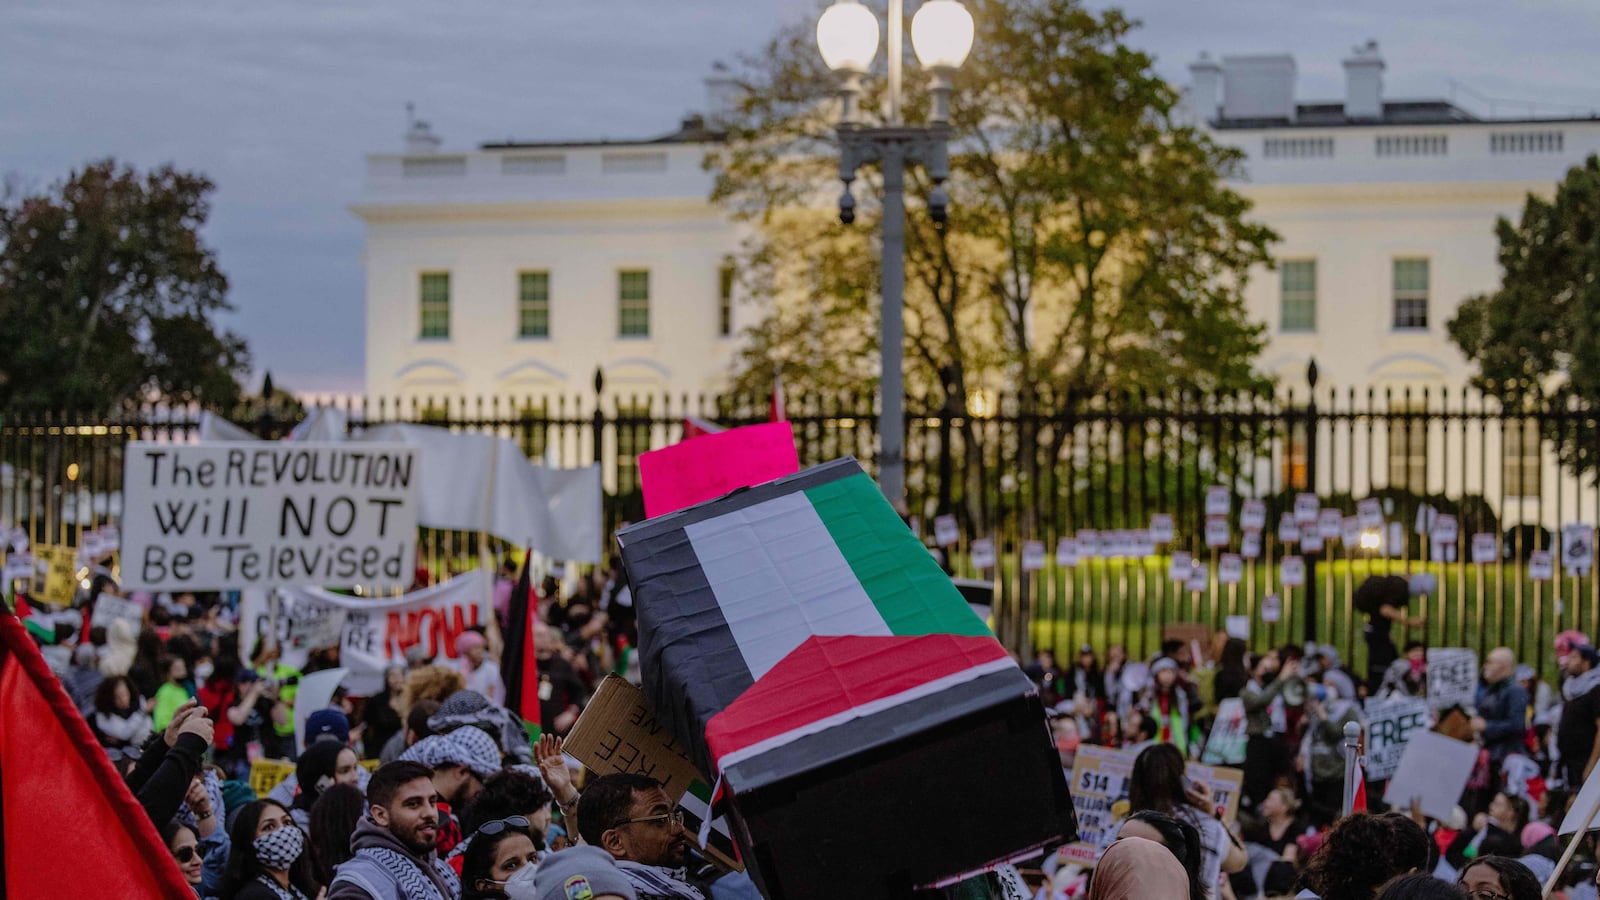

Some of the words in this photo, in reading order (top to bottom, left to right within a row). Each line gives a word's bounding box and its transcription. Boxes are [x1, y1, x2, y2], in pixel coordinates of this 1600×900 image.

[144, 452, 215, 488] The
[224, 448, 413, 489] REVOLUTION
[152, 496, 249, 536] Will
[279, 495, 403, 537] NOT
[141, 545, 195, 583] Be
[212, 543, 404, 582] Televised
[384, 603, 478, 659] NOW
[1369, 711, 1425, 749] FREE
[1081, 771, 1108, 791] $14
